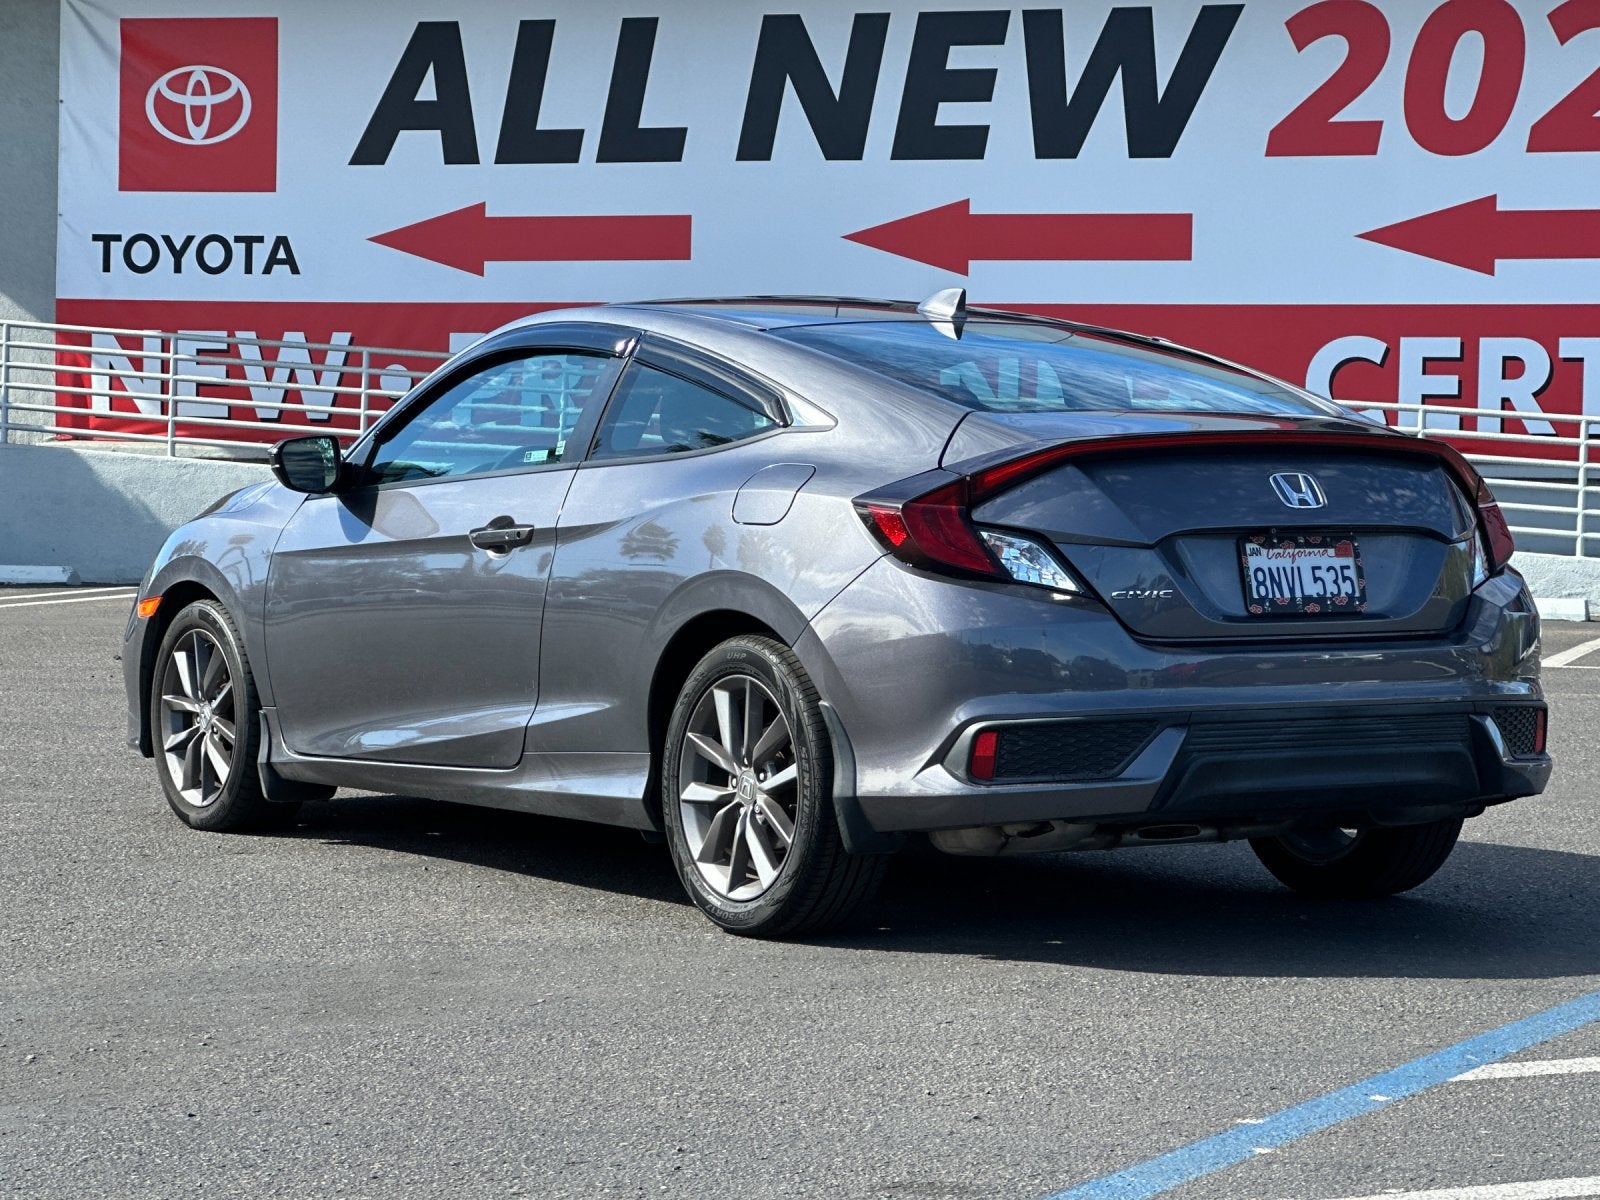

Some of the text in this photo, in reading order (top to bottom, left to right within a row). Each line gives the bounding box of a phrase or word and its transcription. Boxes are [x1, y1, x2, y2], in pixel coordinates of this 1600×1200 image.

[348, 19, 689, 166] ALL
[736, 4, 1246, 162] NEW
[92, 233, 301, 275] TOYOTA
[91, 329, 353, 421] NEW
[1266, 546, 1335, 564] California
[1111, 589, 1174, 600] CIVIC
[1253, 565, 1357, 599] 8NVL535
[726, 652, 747, 660] UHP
